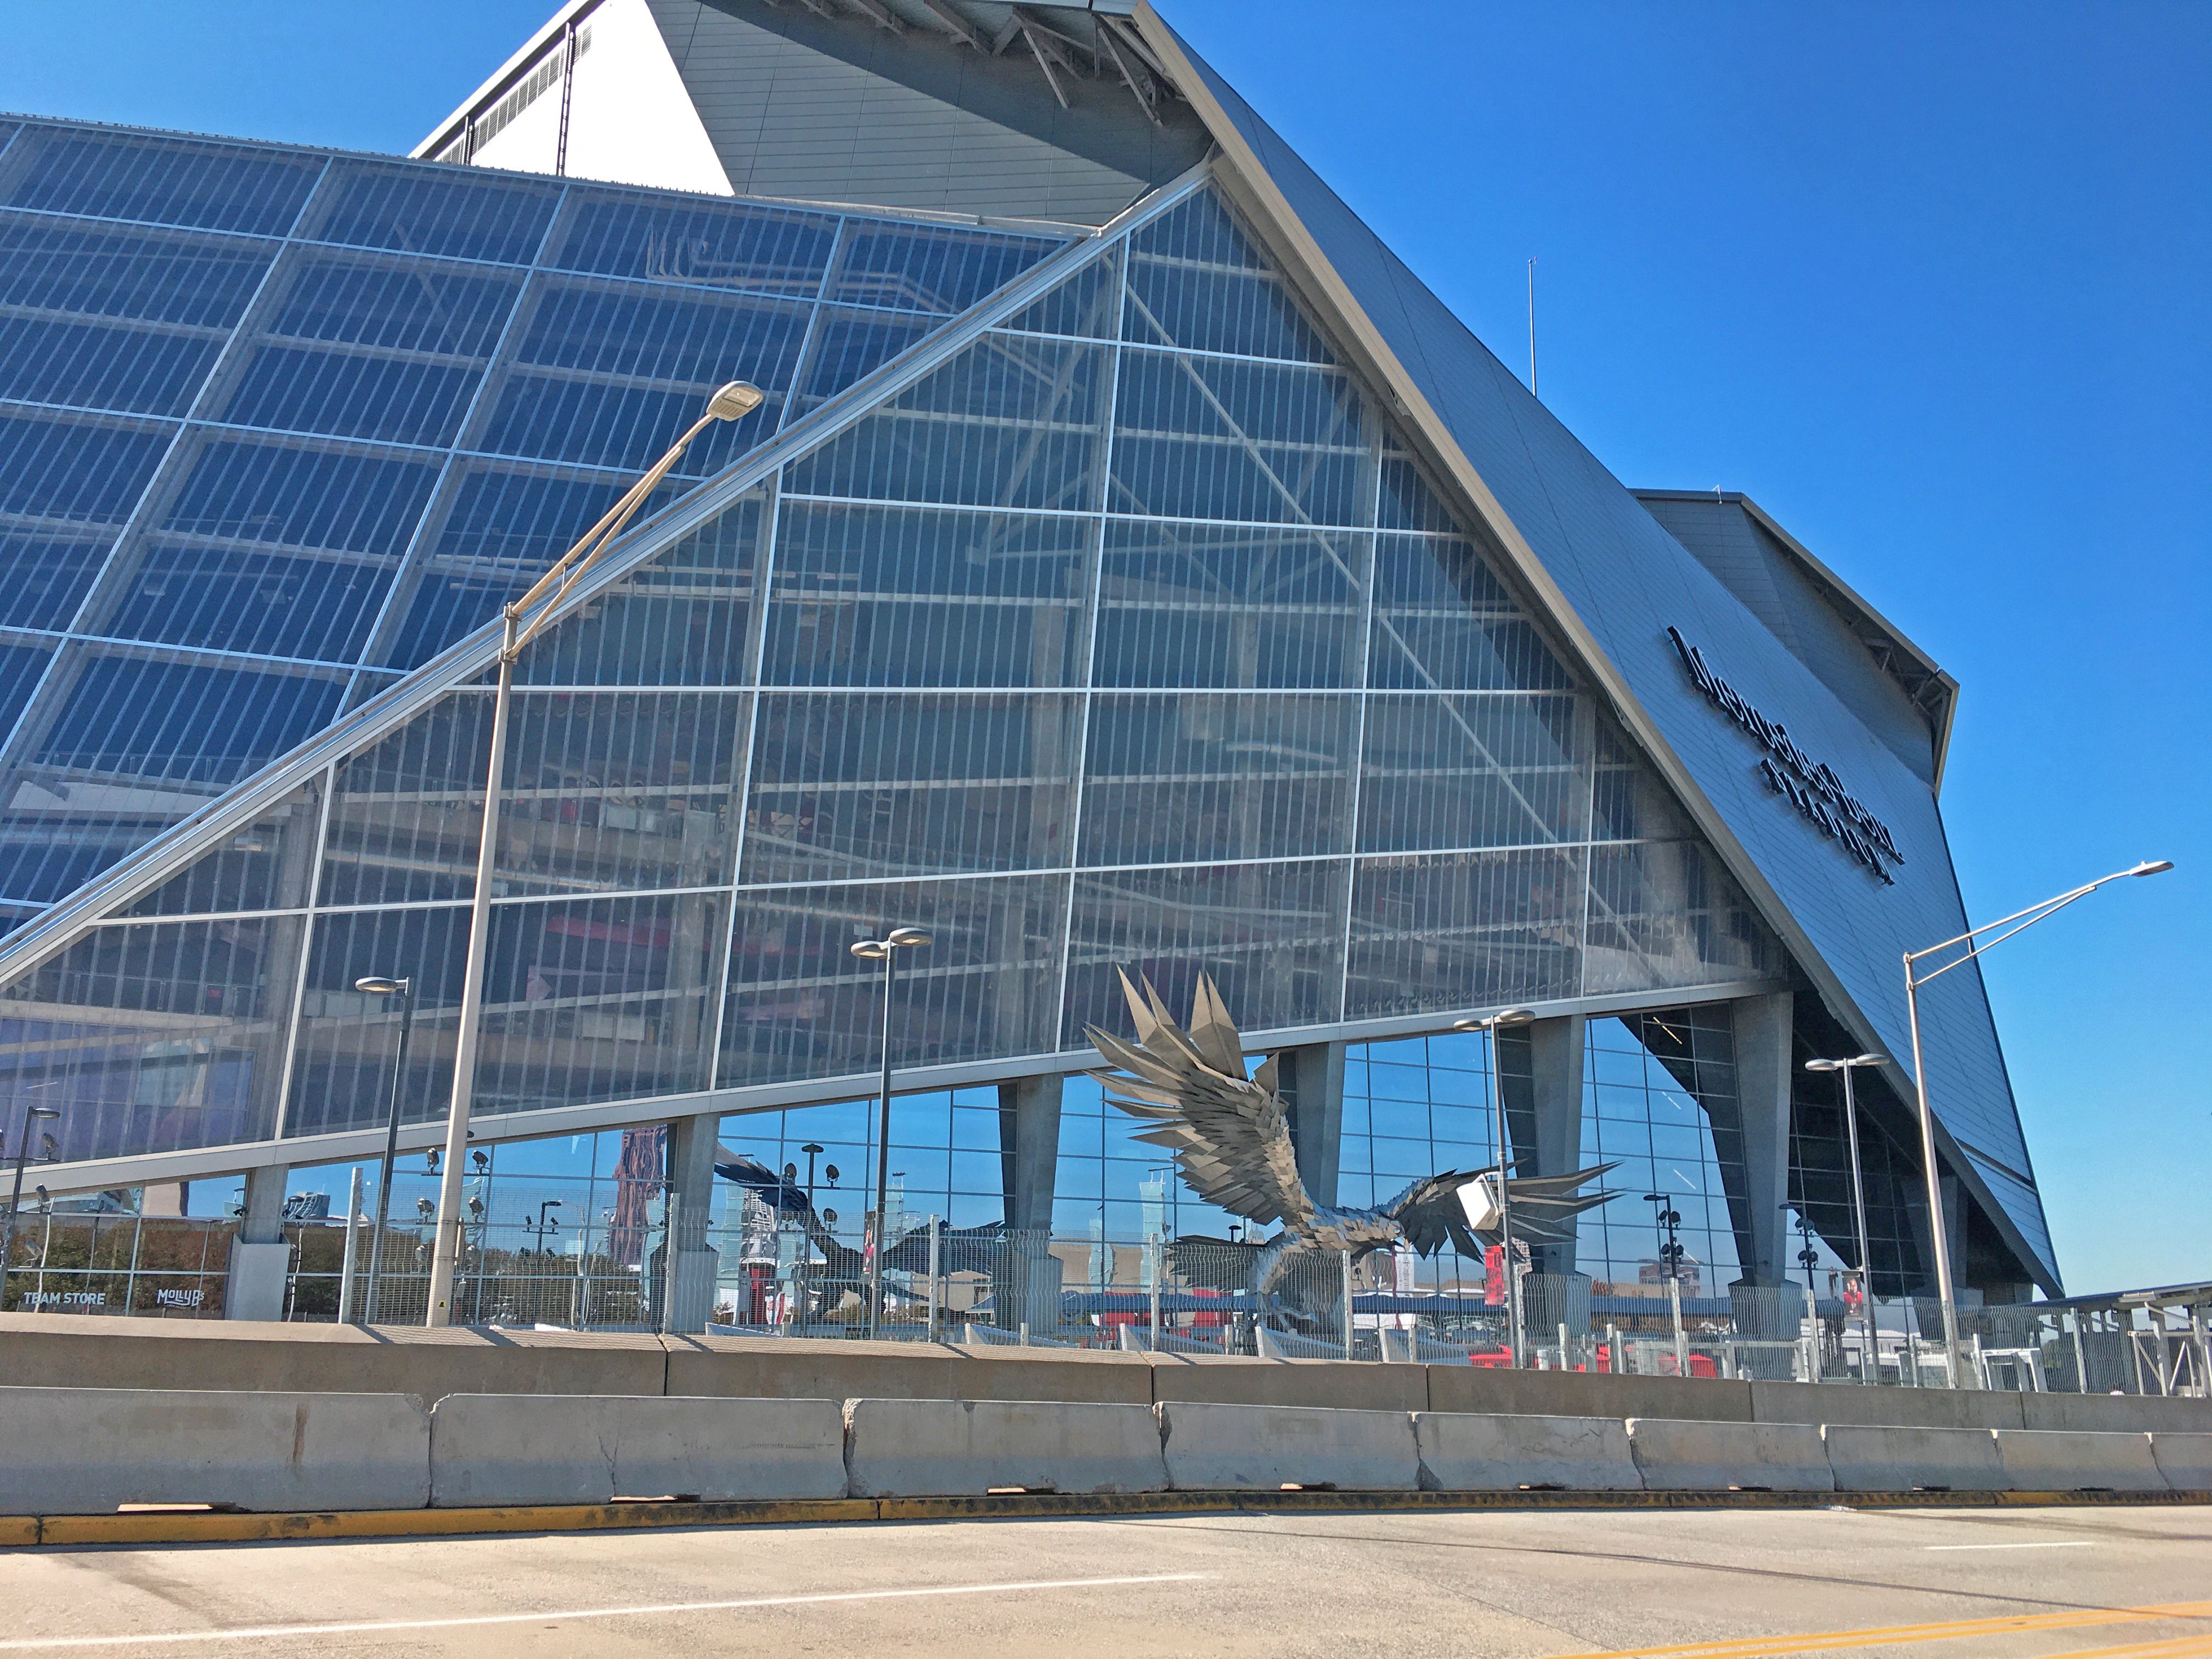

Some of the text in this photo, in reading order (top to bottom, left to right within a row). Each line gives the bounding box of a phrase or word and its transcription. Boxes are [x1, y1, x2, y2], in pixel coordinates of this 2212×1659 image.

[1667, 625, 1905, 865] Mercedes-Benz
[1761, 758, 1895, 885] STADIUM
[24, 1292, 106, 1305] TEAM STORE
